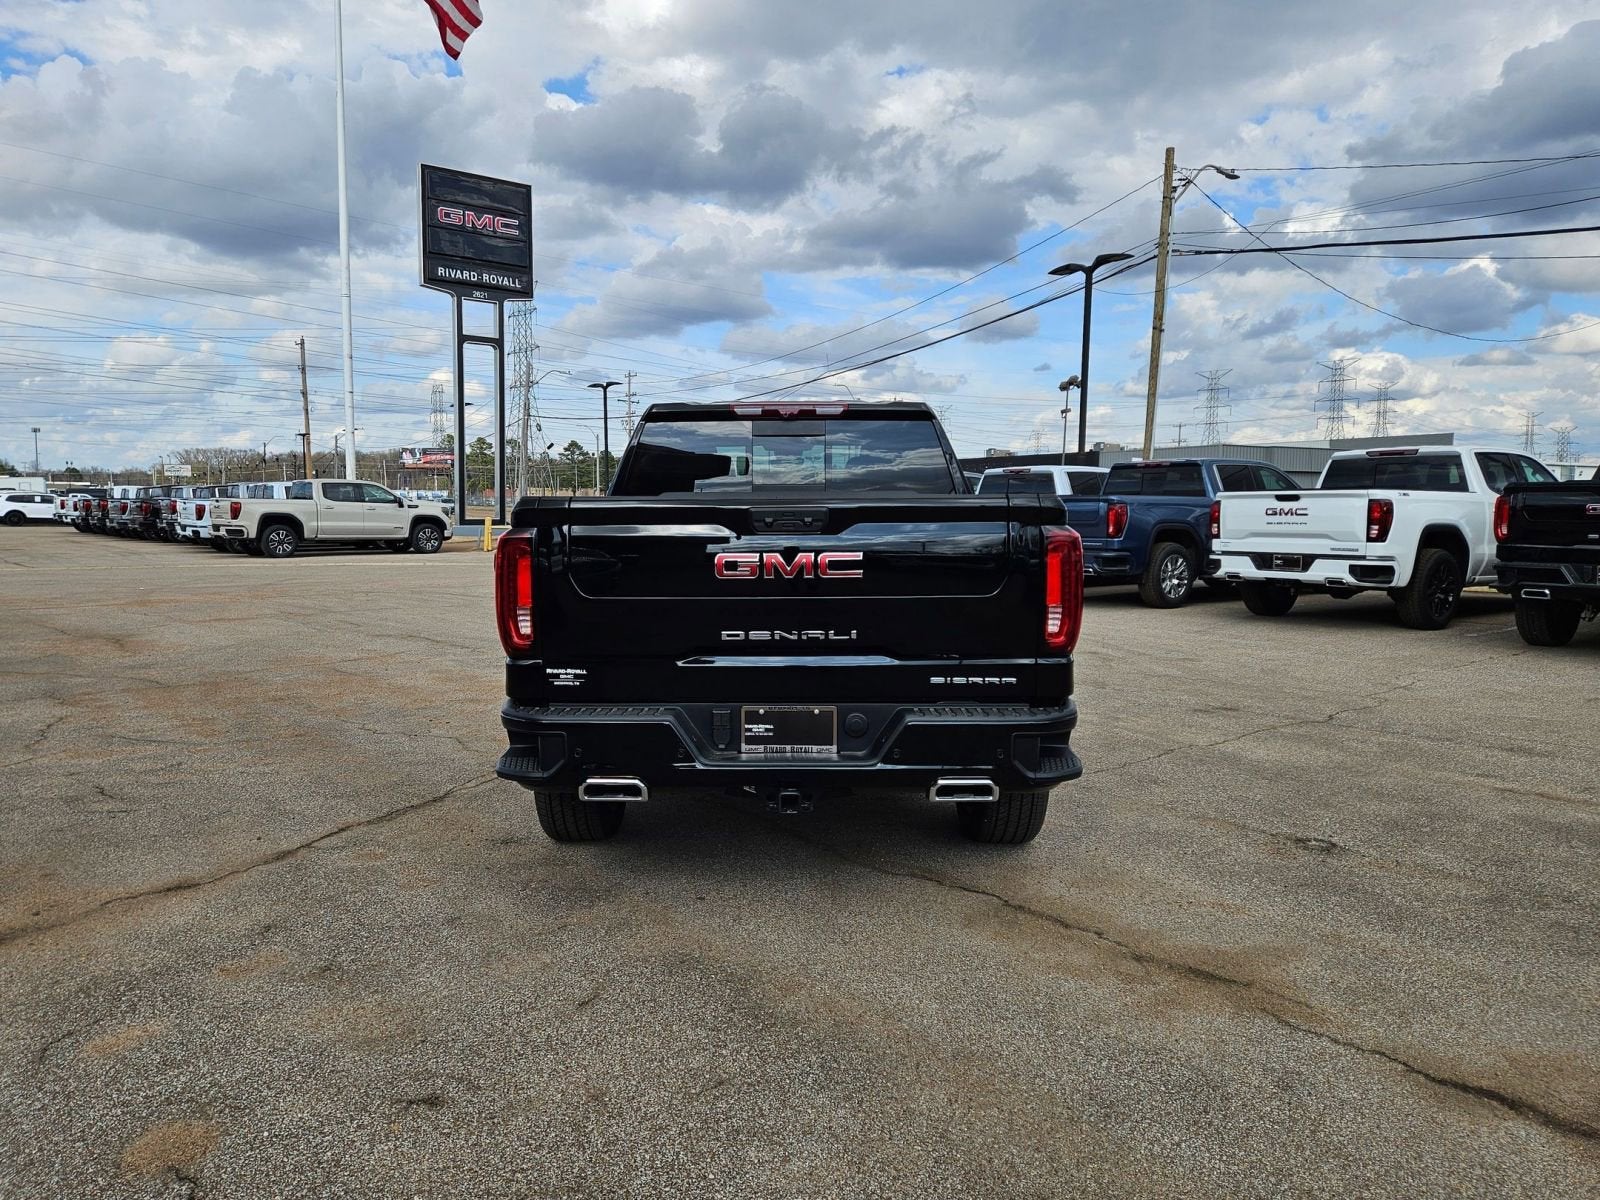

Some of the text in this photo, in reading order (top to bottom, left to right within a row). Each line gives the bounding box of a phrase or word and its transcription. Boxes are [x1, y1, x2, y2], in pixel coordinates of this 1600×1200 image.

[437, 206, 519, 236] GMC
[437, 266, 522, 288] RIVARD-ROYALL
[472, 290, 488, 299] 2621
[1265, 507, 1309, 516] GMC
[714, 551, 864, 579] GMC
[720, 630, 858, 641] DENALI
[929, 676, 1017, 684] SIERRA
